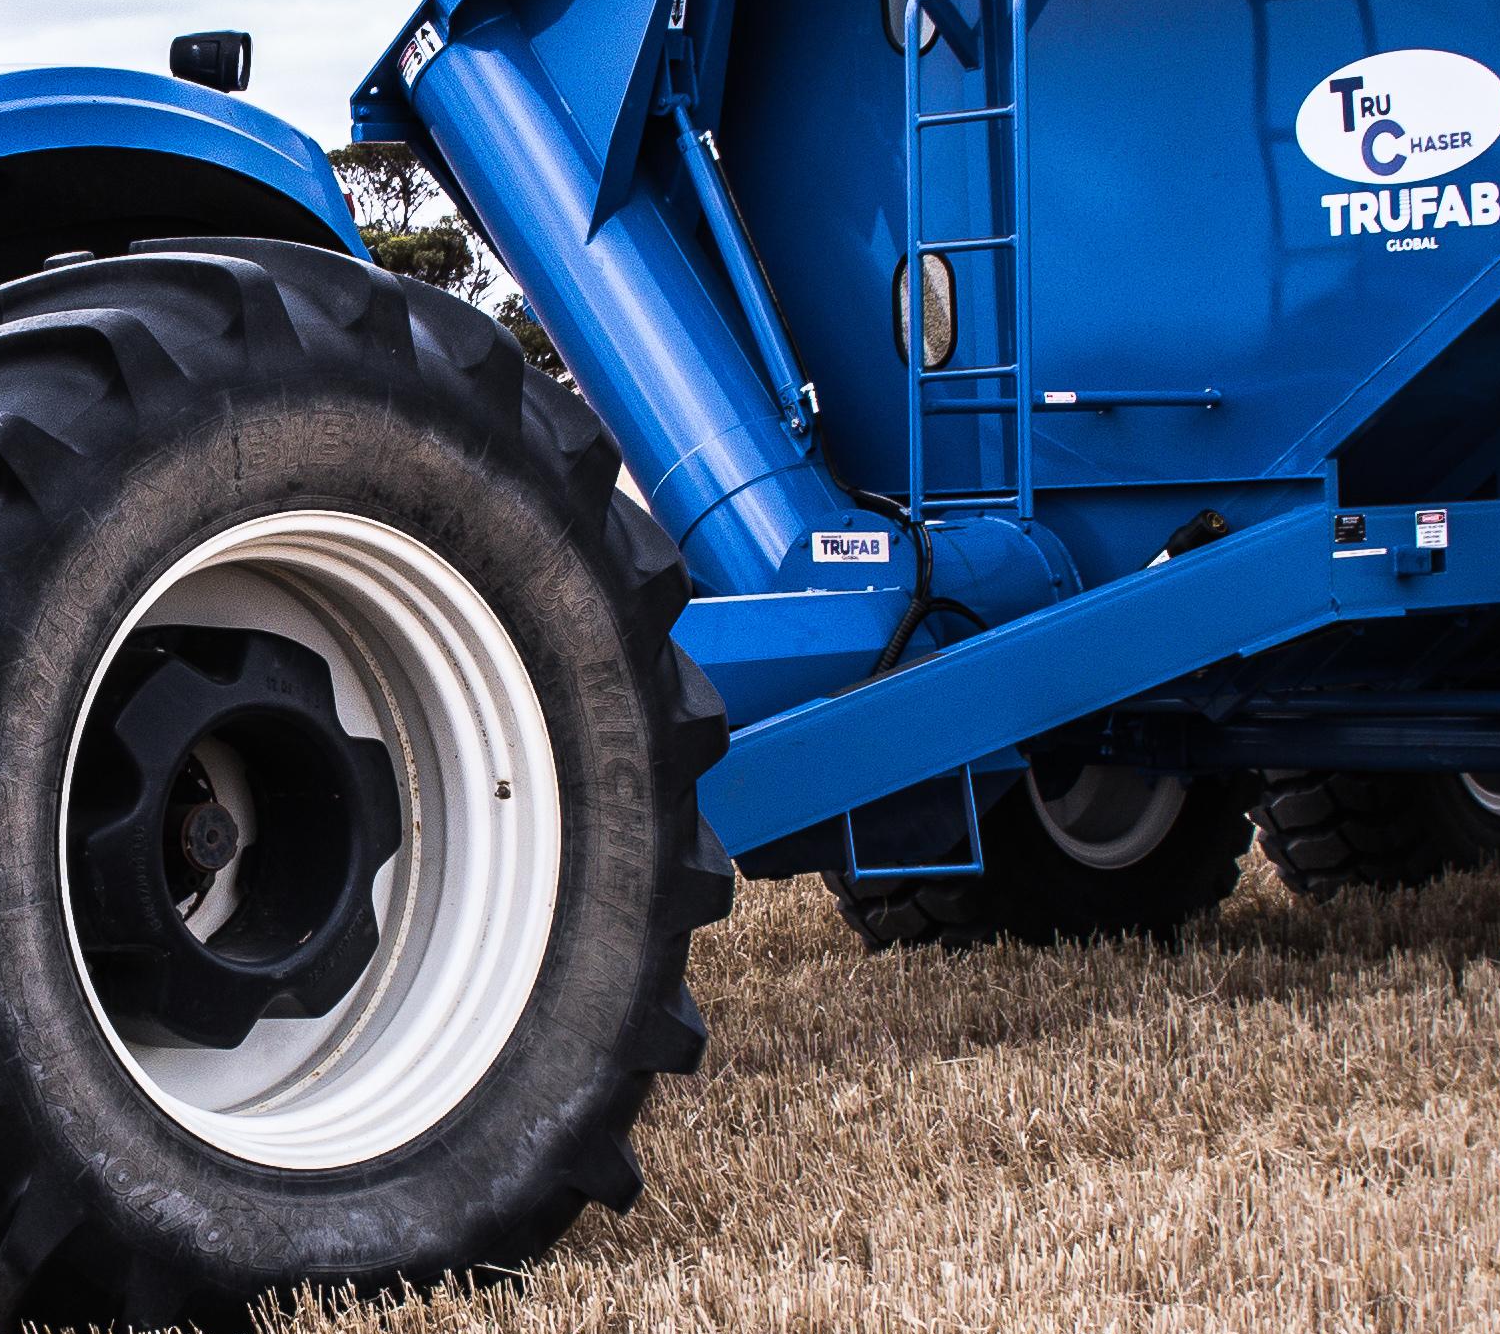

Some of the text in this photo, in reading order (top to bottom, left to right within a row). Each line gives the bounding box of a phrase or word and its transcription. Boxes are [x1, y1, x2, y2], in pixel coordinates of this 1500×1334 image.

[1321, 182, 1500, 236] TRUFAB
[1386, 236, 1439, 252] GLOBAL
[821, 539, 880, 556] TRUFAB
